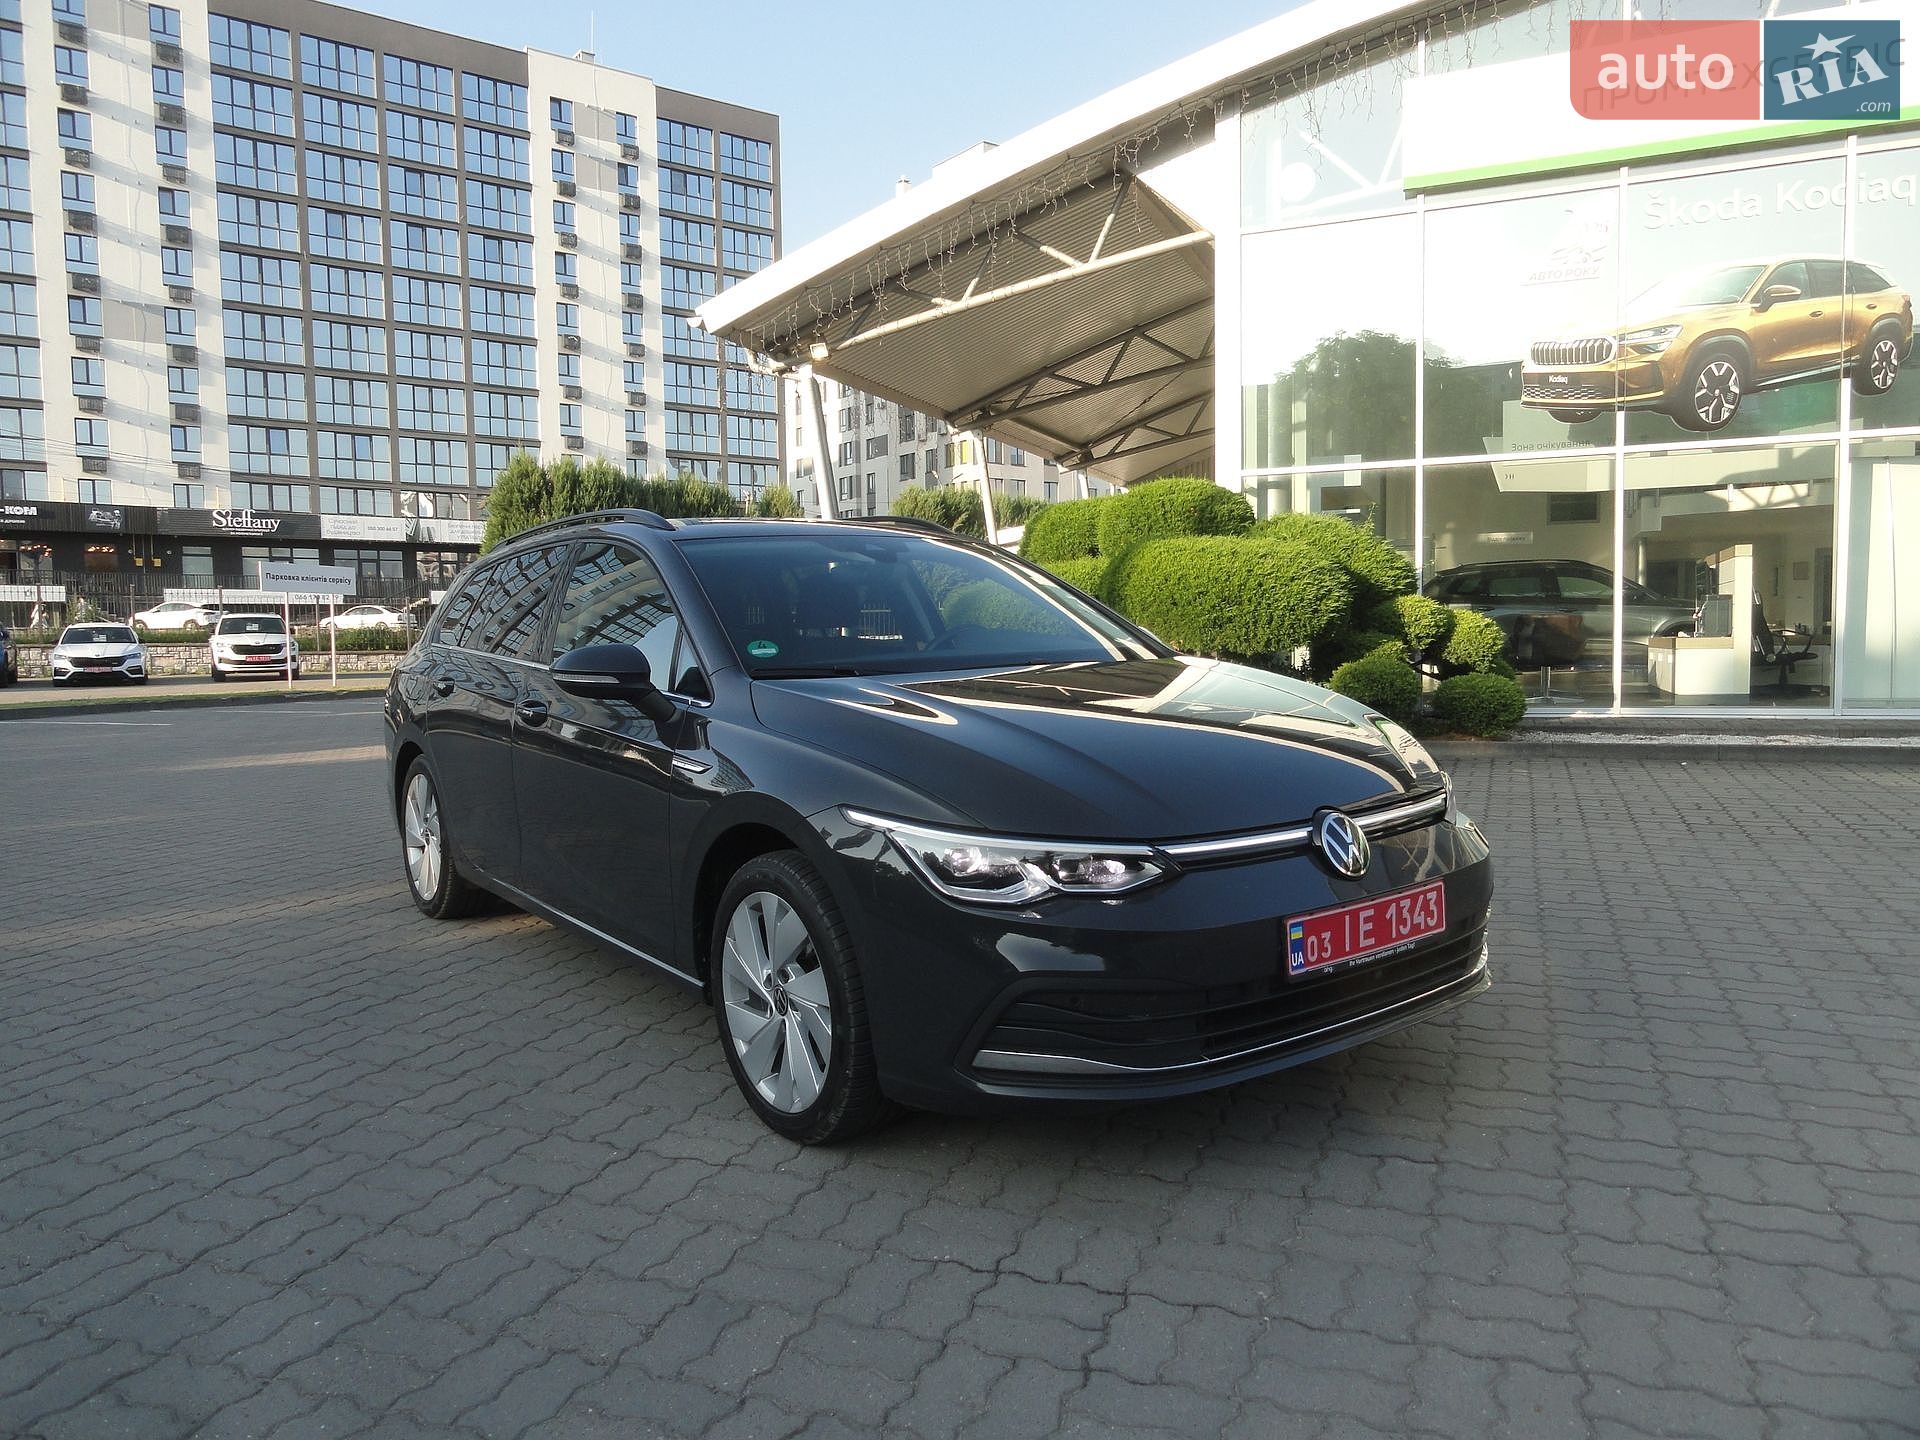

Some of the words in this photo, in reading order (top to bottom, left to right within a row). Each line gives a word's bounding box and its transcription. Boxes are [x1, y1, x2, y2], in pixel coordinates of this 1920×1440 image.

[1644, 188, 1763, 230] Škoda
[1511, 442, 1535, 452] Зона
[212, 508, 281, 533] Steffany
[265, 573, 300, 582] Парковка
[301, 575, 328, 583] клієнтів
[328, 576, 352, 586] сервісу
[1306, 930, 1332, 963] 03
[1385, 890, 1438, 939] 1343
[1291, 951, 1305, 967] UA
